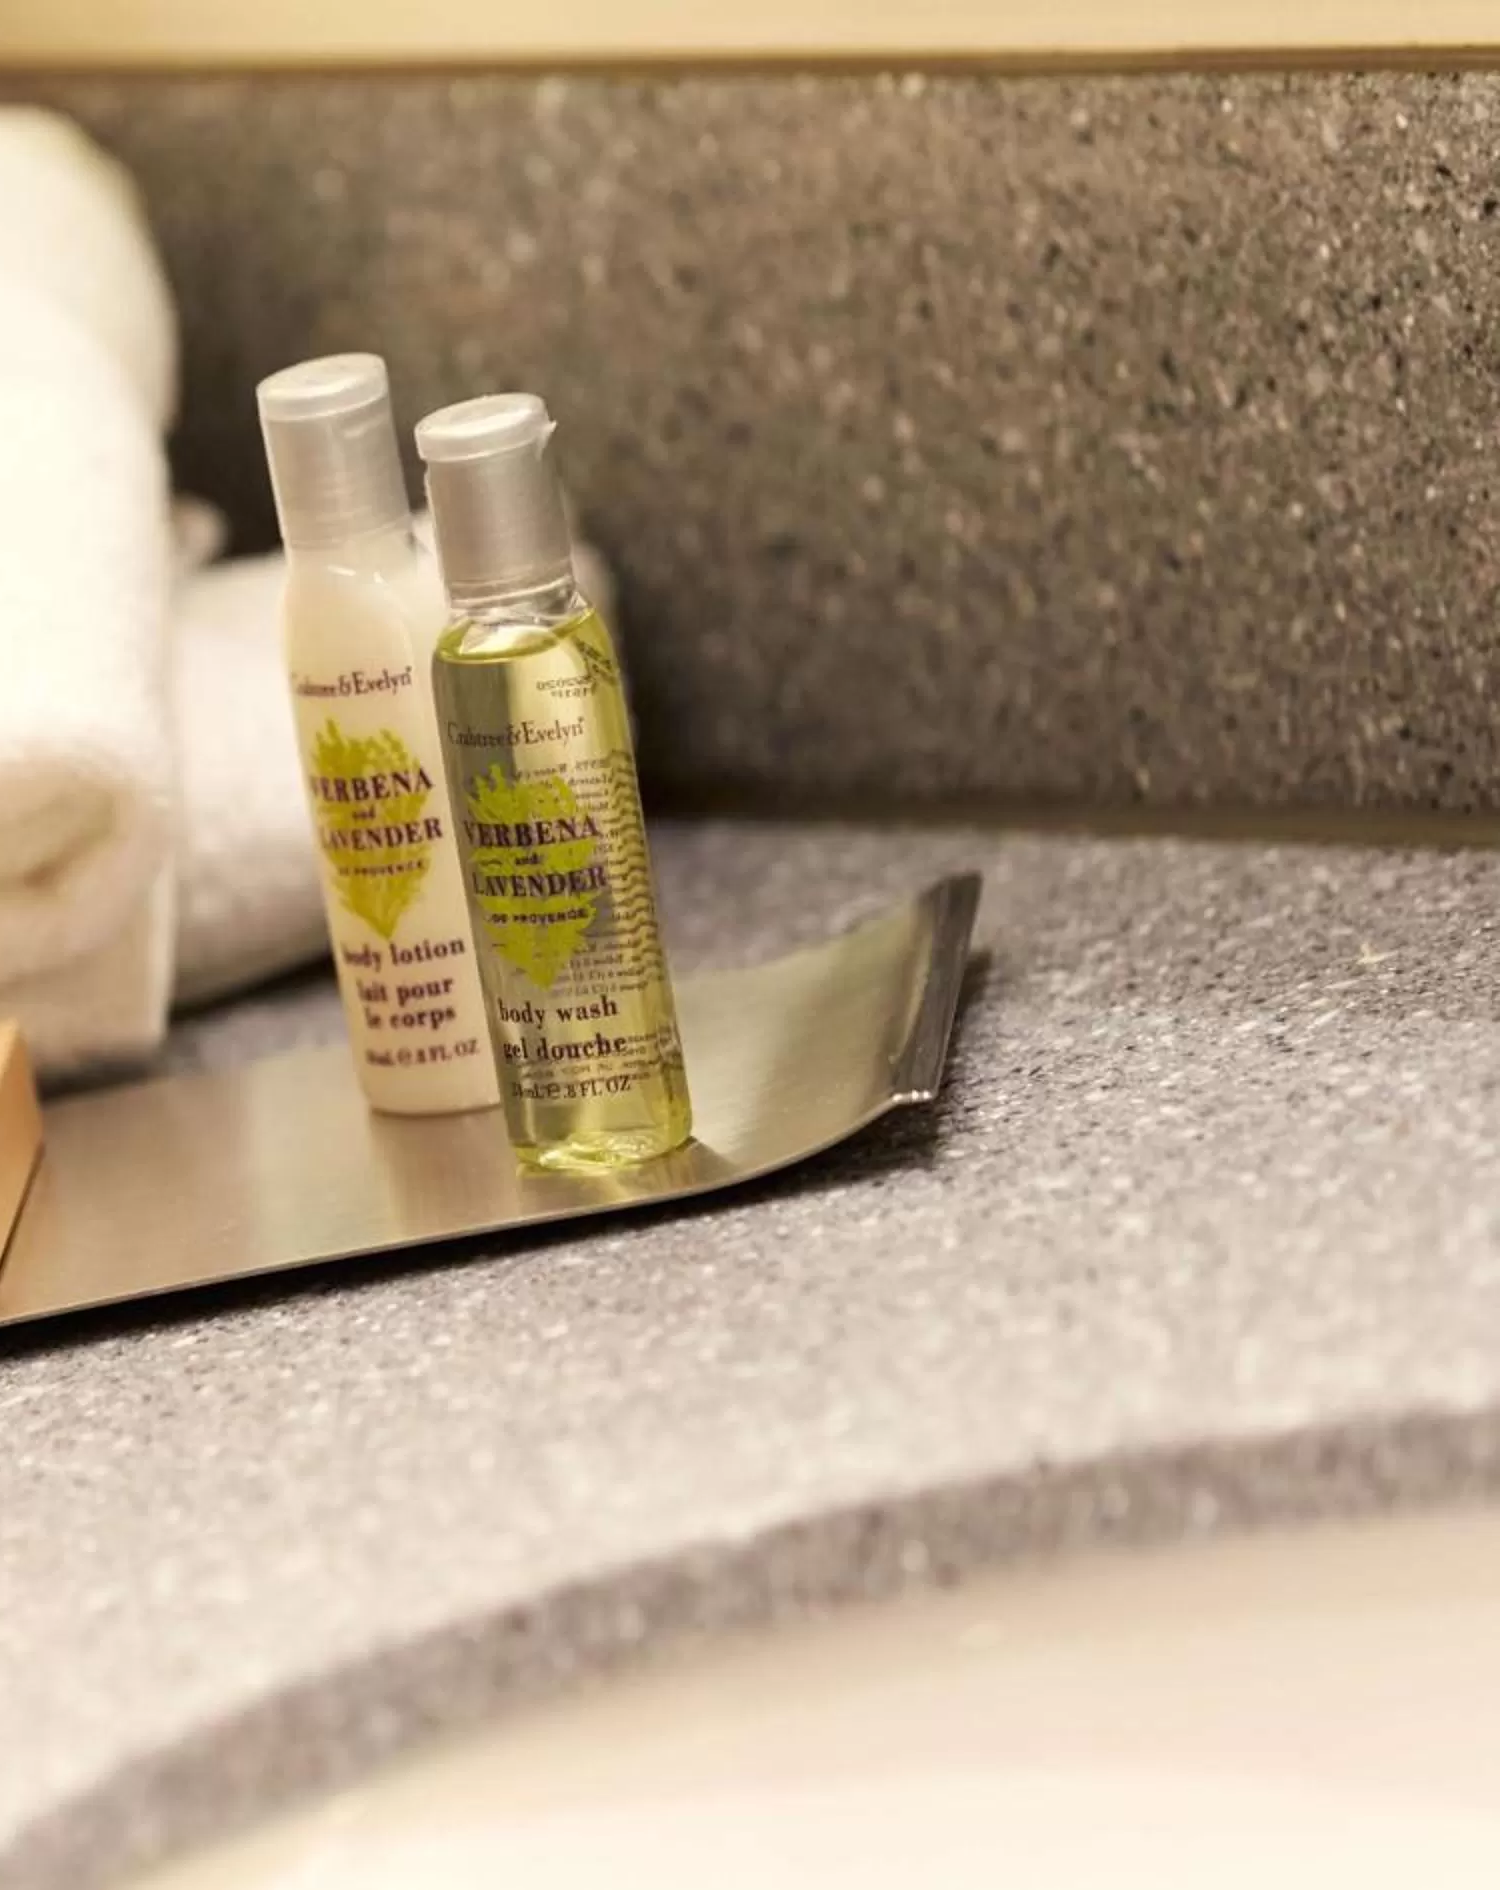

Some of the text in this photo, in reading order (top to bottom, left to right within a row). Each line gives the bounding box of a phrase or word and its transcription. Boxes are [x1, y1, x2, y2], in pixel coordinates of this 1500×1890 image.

[463, 816, 601, 848] VERBENA
[514, 853, 539, 867] and
[472, 865, 608, 898] LAVENDER
[389, 938, 466, 967] lotion
[396, 977, 454, 1008] pour
[389, 1005, 457, 1031] corps
[497, 995, 619, 1030] body wash
[502, 1031, 628, 1064] gel douche
[606, 1073, 633, 1094] OZ
